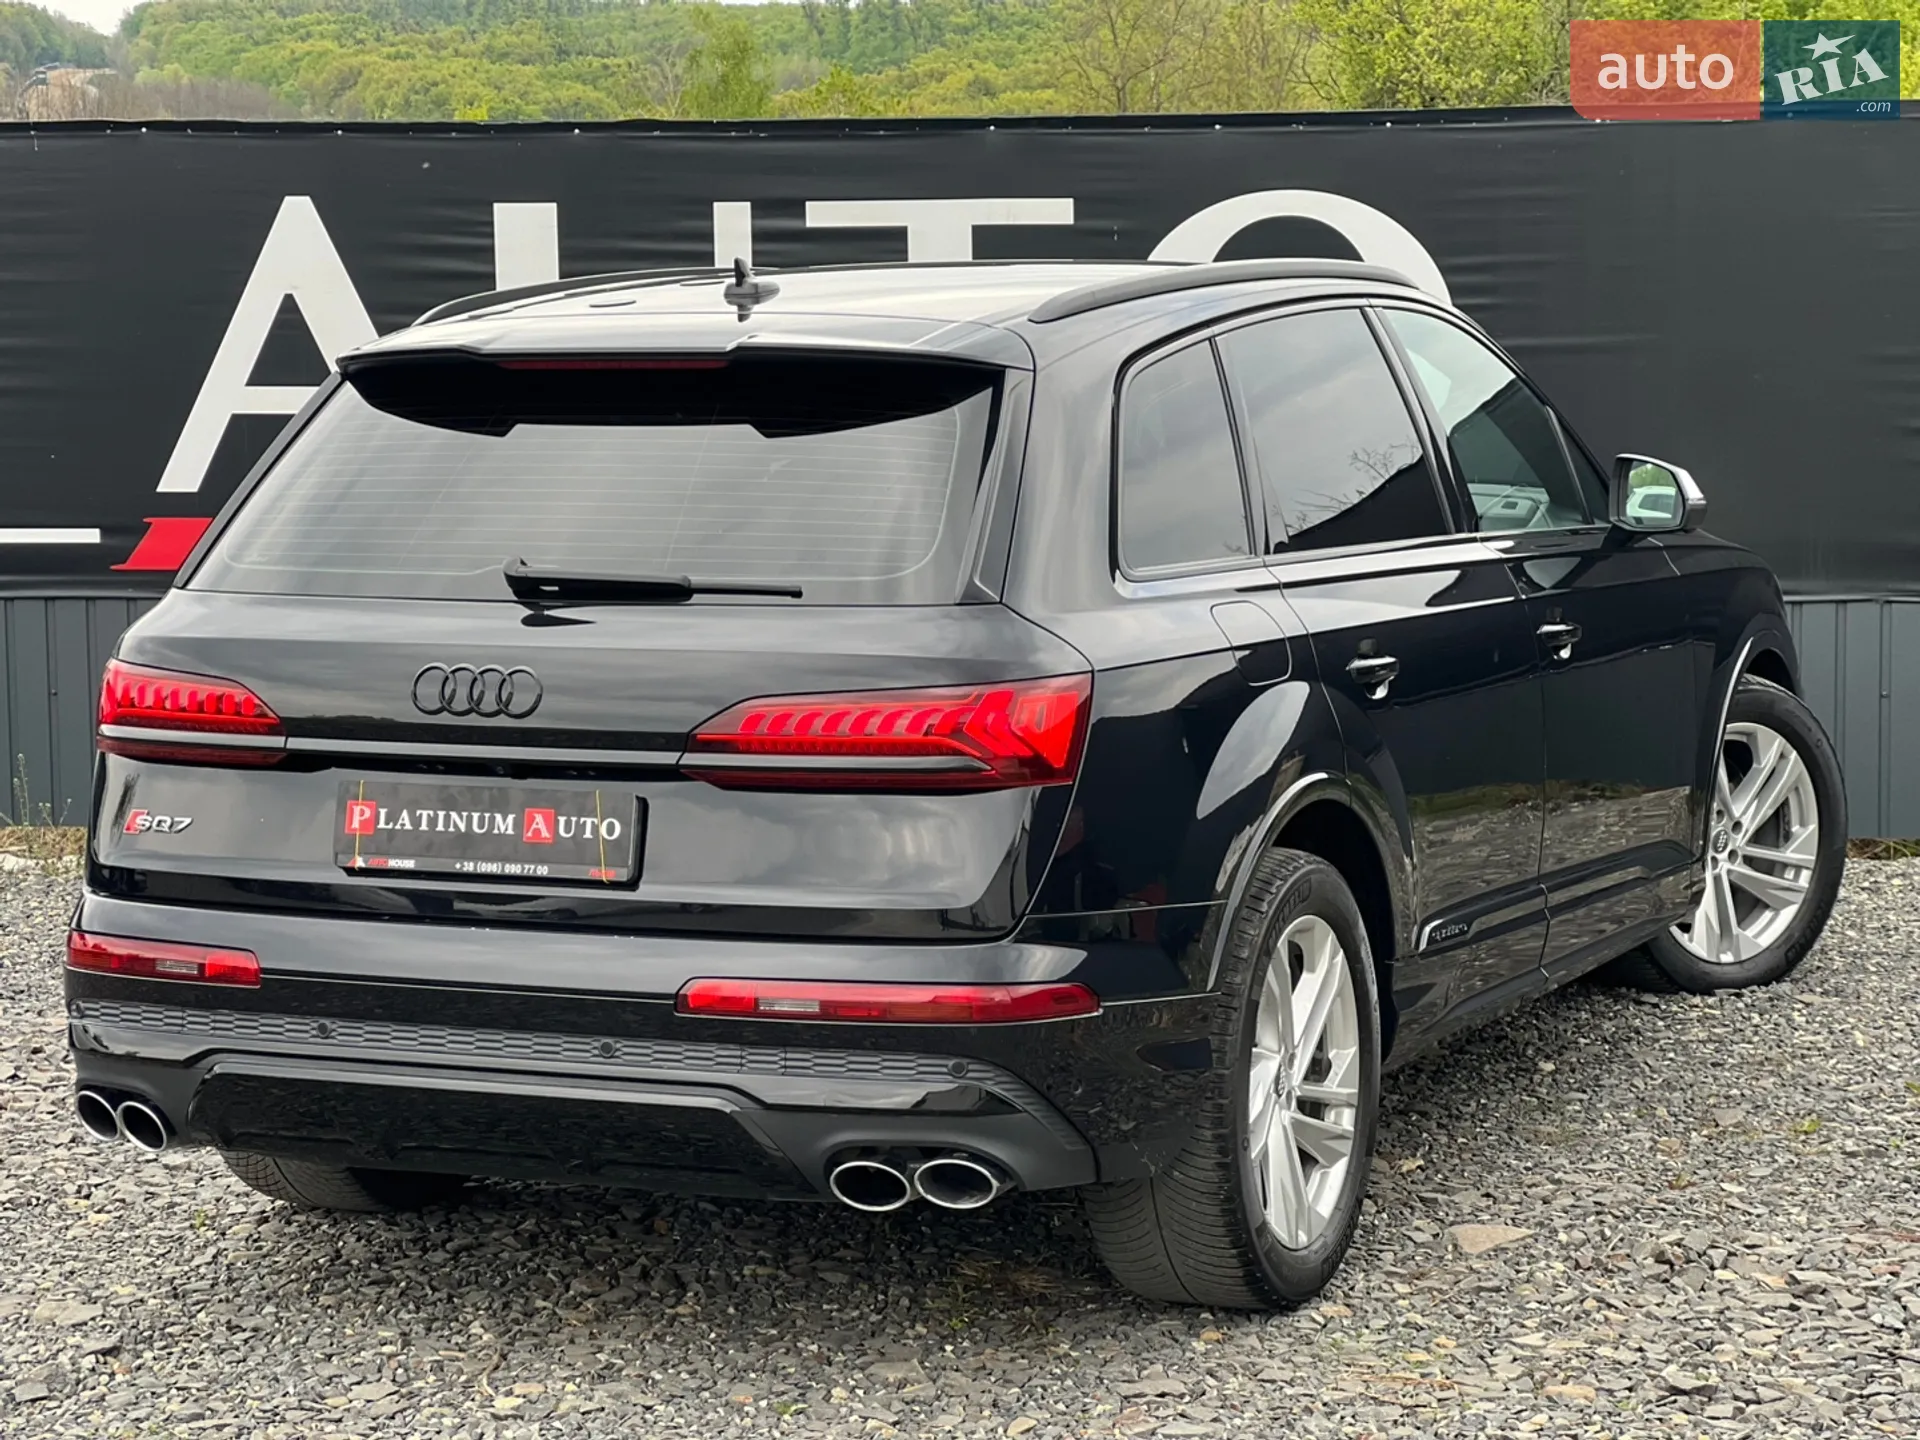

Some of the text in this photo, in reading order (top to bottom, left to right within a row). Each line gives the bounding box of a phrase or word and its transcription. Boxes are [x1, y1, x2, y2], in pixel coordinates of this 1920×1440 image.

[134, 814, 193, 834] SQ7
[349, 803, 622, 841] PLATINUM AUTO
